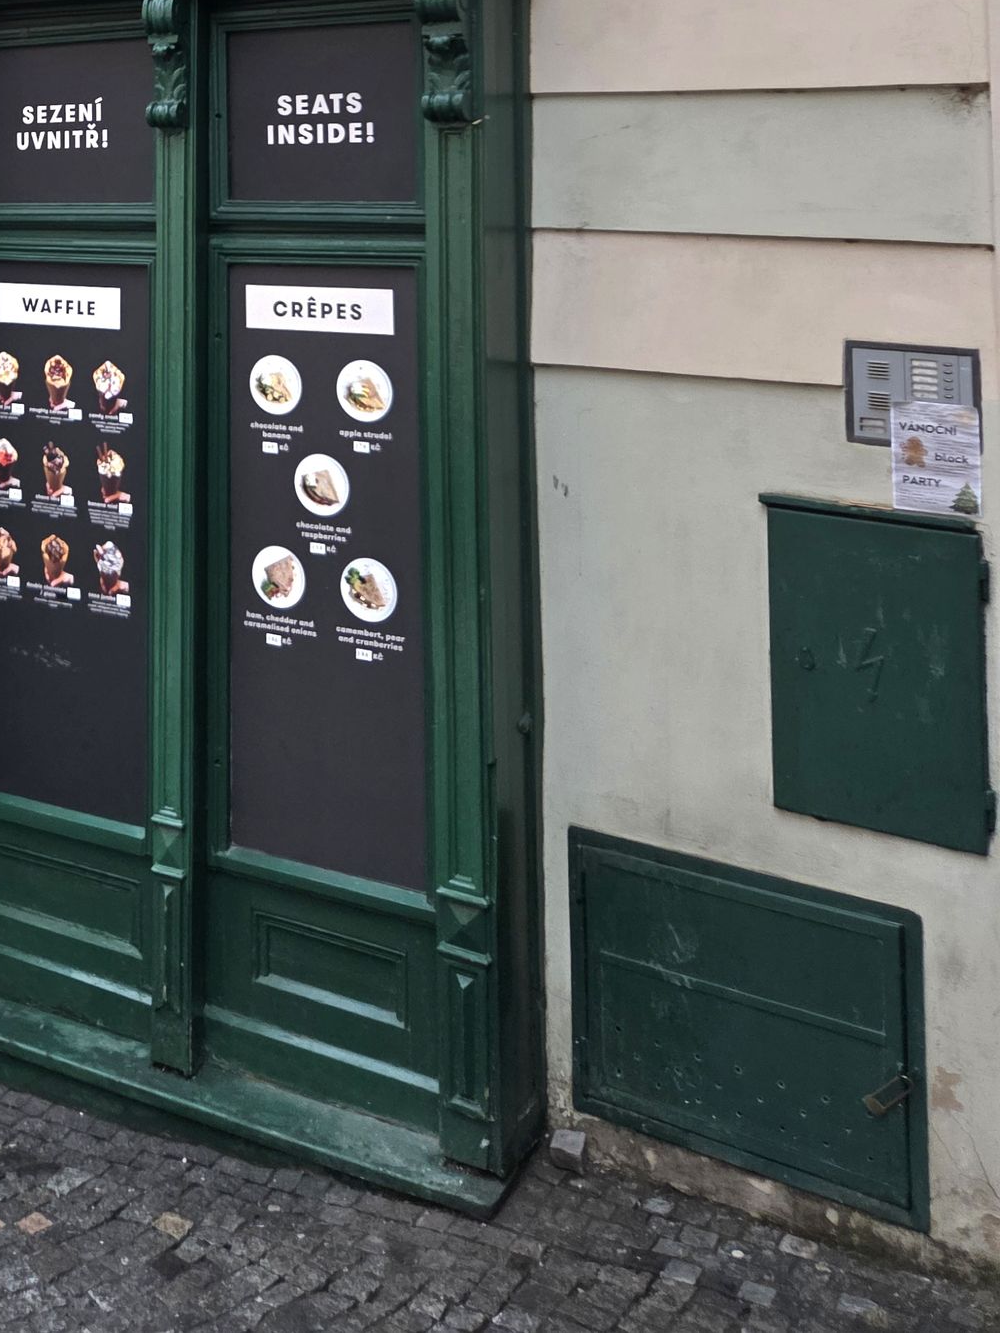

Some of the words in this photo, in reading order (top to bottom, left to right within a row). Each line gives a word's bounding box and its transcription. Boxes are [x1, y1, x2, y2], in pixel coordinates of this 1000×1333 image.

[21, 97, 104, 125] SEZENÍ
[276, 92, 364, 117] SEATS
[15, 123, 109, 151] UVNITŘ!
[266, 121, 376, 146] INSIDE!
[22, 297, 96, 316] WAFFLE
[273, 296, 363, 321] CRÊPES
[899, 421, 957, 436] VÁNOČNÍ
[934, 452, 969, 465] block
[902, 474, 942, 488] PARTY
[295, 520, 334, 532] chocolate
[301, 531, 347, 543] raspberries
[265, 614, 298, 625] cheddar
